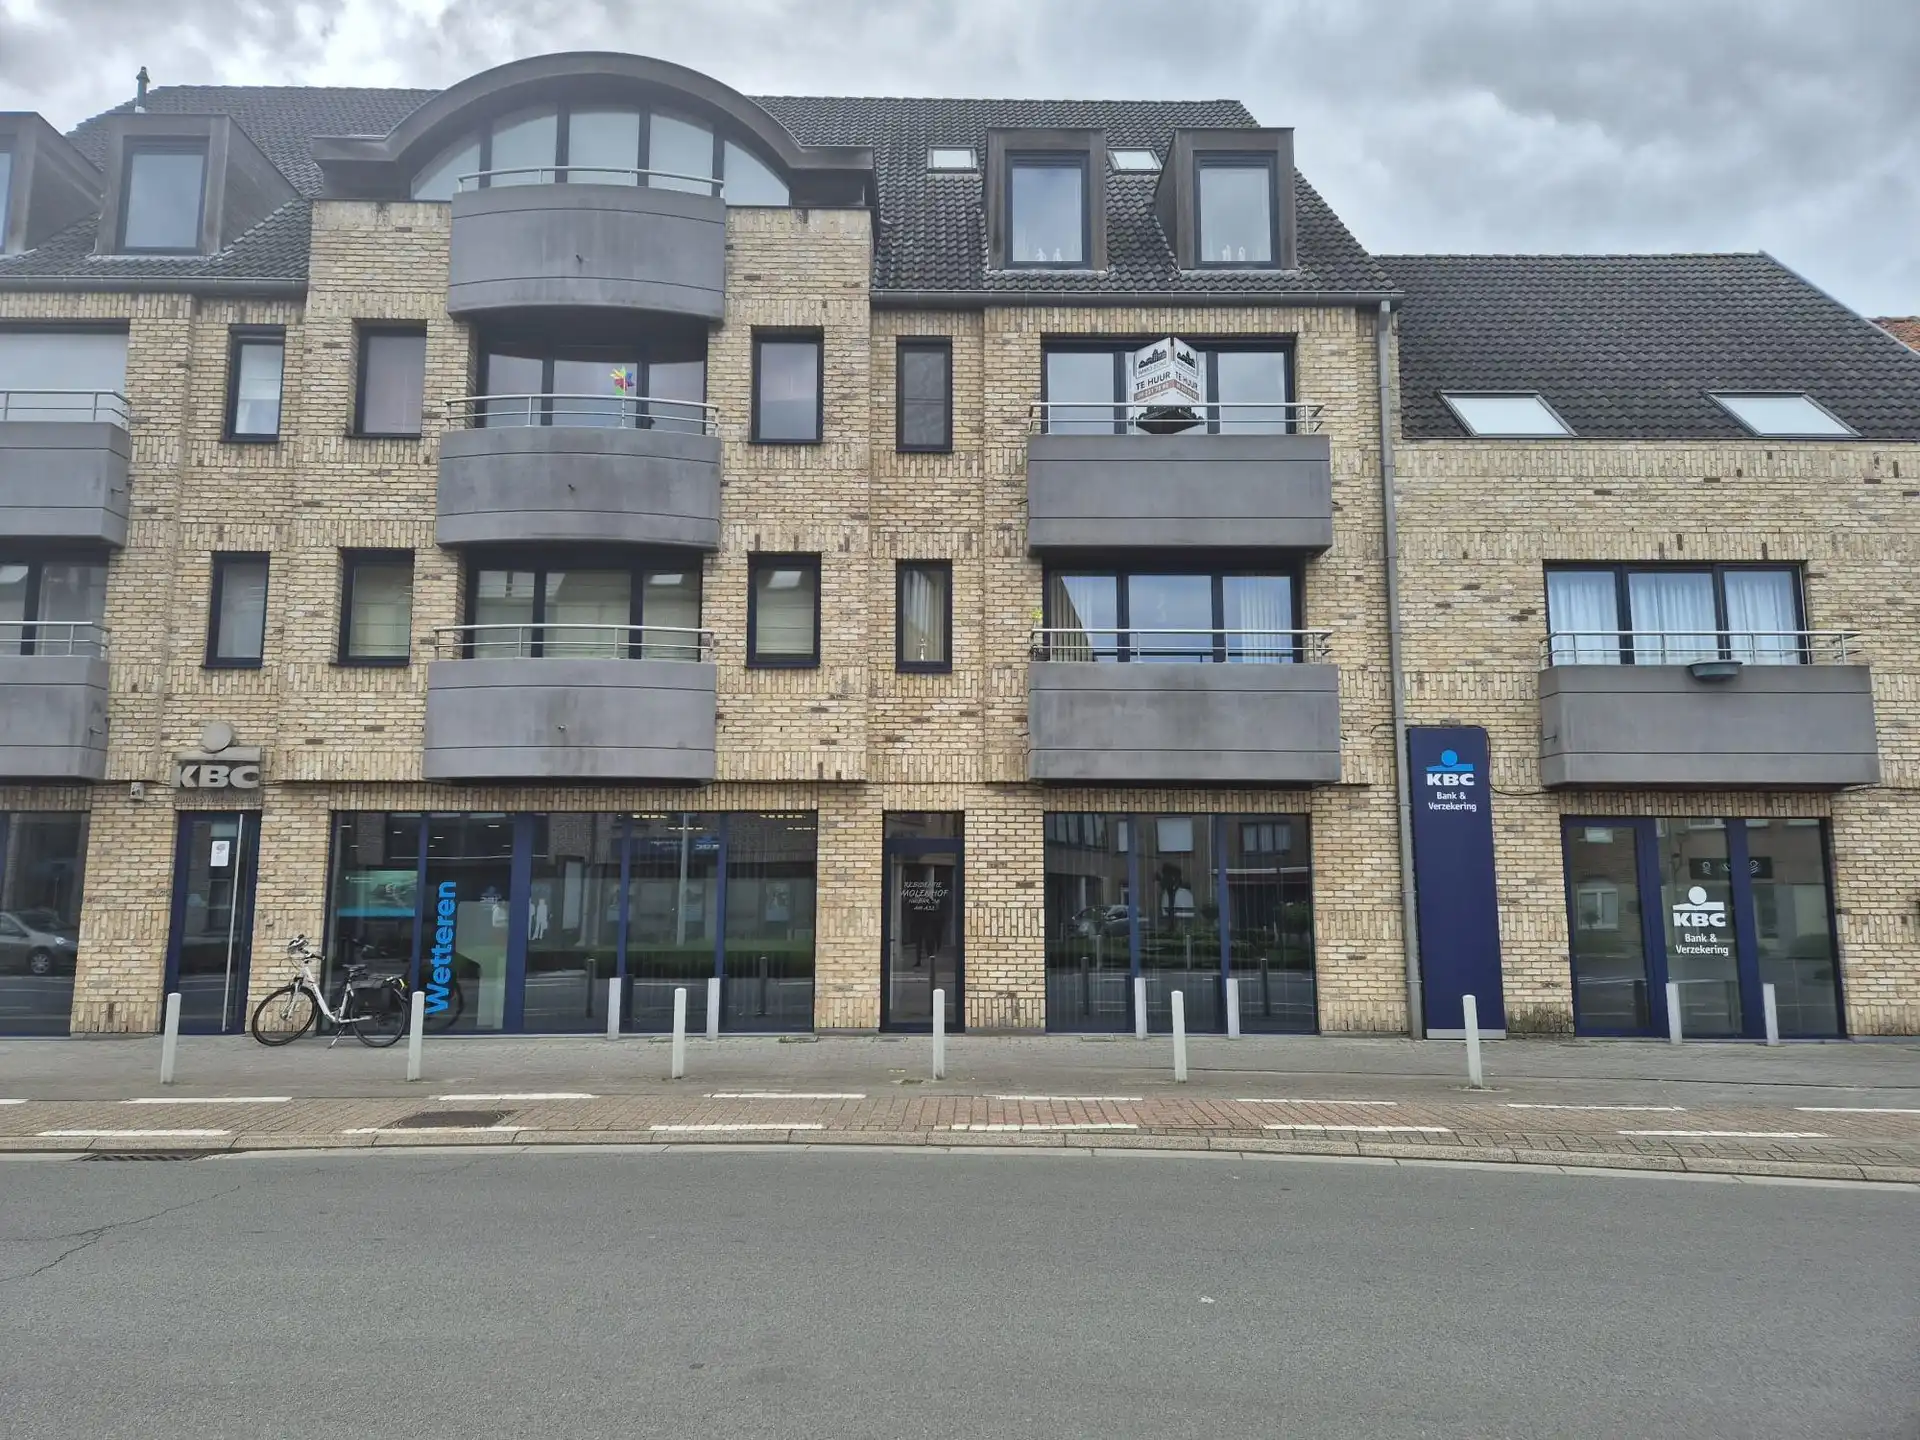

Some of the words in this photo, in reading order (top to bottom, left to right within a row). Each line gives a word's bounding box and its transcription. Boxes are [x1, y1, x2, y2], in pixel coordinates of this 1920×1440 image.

[1136, 381, 1145, 390] TE
[1147, 371, 1171, 386] HUUR
[170, 765, 260, 788] KBC
[1426, 773, 1475, 786] KBC
[1437, 792, 1457, 800] Bank
[1459, 792, 1466, 800] &
[1428, 802, 1477, 812] Verzekering
[1673, 912, 1726, 927] KBC
[1685, 933, 1707, 942] Bank
[1709, 933, 1717, 942] &
[425, 881, 456, 1014] Wetteren
[1675, 944, 1729, 956] Verzekering
